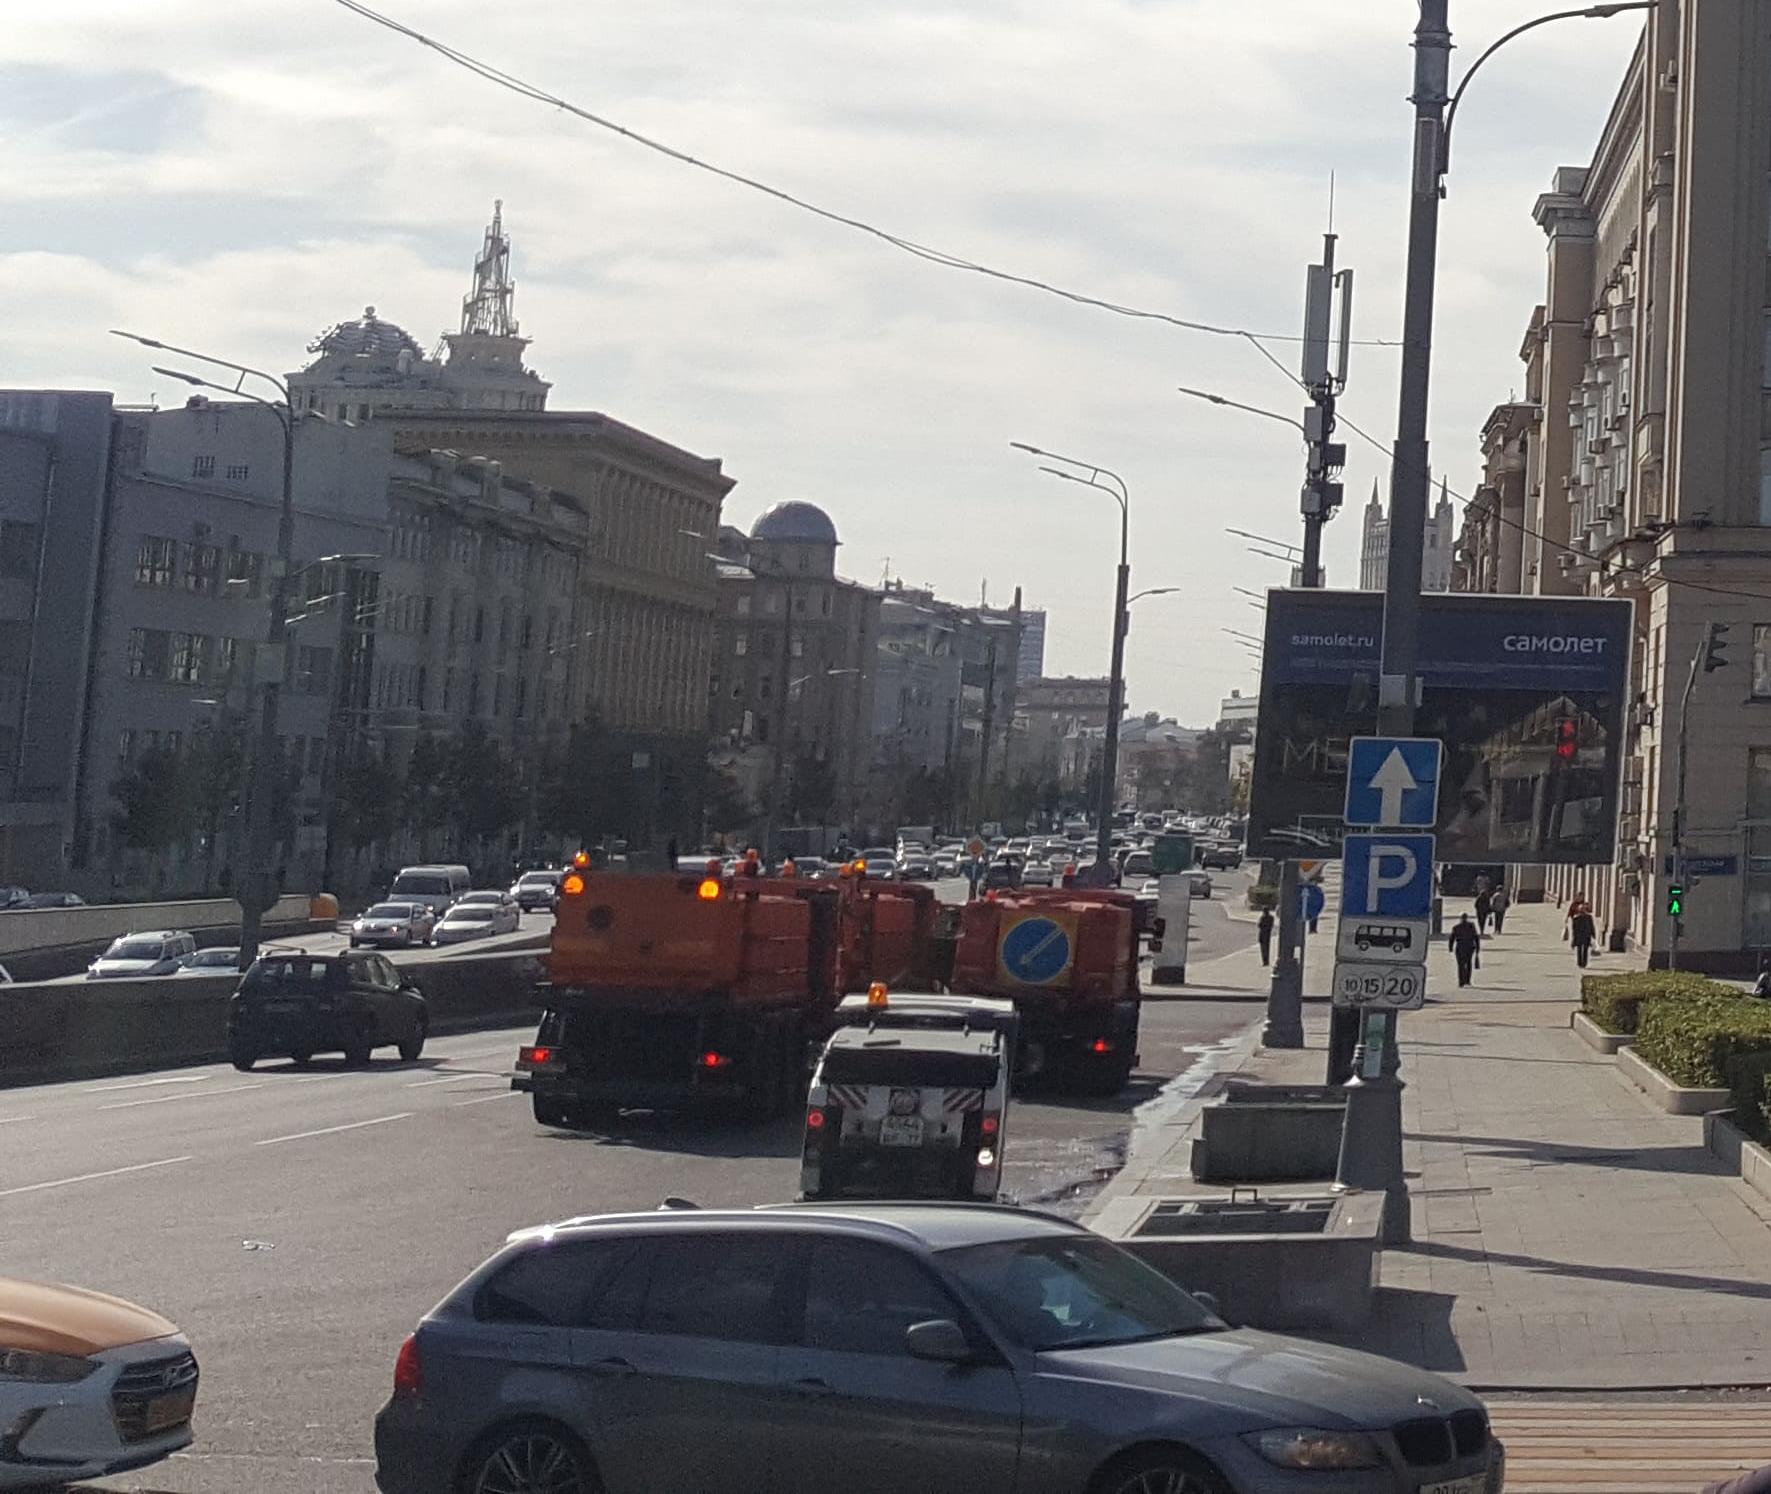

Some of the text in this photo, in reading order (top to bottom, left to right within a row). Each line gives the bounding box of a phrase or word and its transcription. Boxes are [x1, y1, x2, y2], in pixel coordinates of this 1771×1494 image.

[1291, 633, 1374, 648] samolet.ru
[1503, 632, 1608, 653] самолет
[1366, 845, 1417, 912] P
[1345, 978, 1413, 996] 10 15 20
